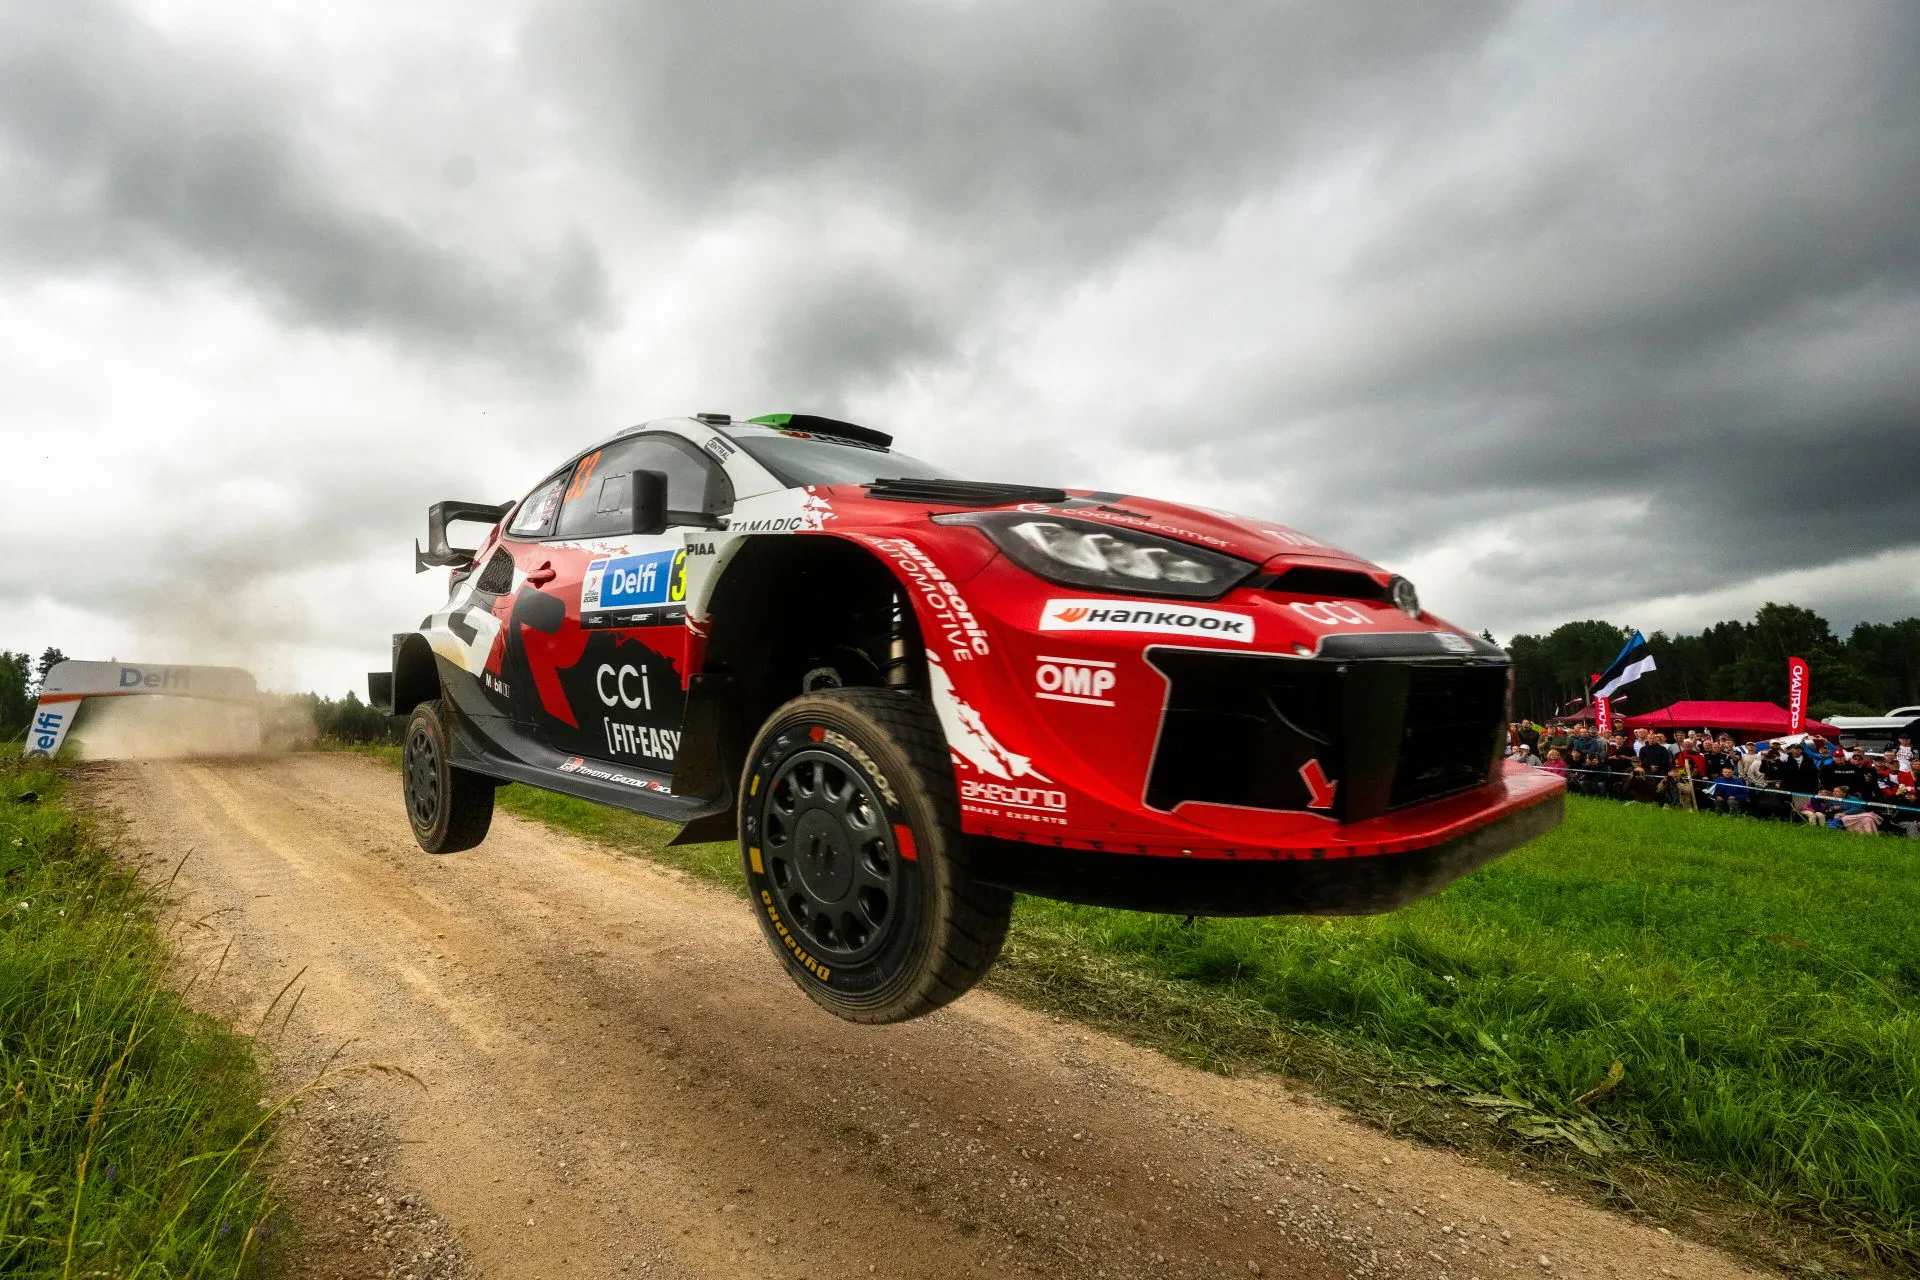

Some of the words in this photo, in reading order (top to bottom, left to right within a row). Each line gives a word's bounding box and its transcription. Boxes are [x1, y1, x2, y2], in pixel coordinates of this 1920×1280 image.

[706, 439, 730, 461] CENTRAL
[563, 450, 602, 503] 33
[732, 517, 802, 531] TAMADIC
[686, 543, 715, 556] PIAA
[611, 562, 658, 595] Delfi
[863, 537, 974, 662] AUTOMOTIVE
[888, 538, 990, 656] Panasonic
[119, 667, 192, 690] Delfi
[596, 663, 652, 711] CCi
[1035, 663, 1116, 697] OMP
[960, 780, 1067, 809] akebono
[961, 804, 1000, 816] BRAKE
[1005, 811, 1068, 825] EXPERTS
